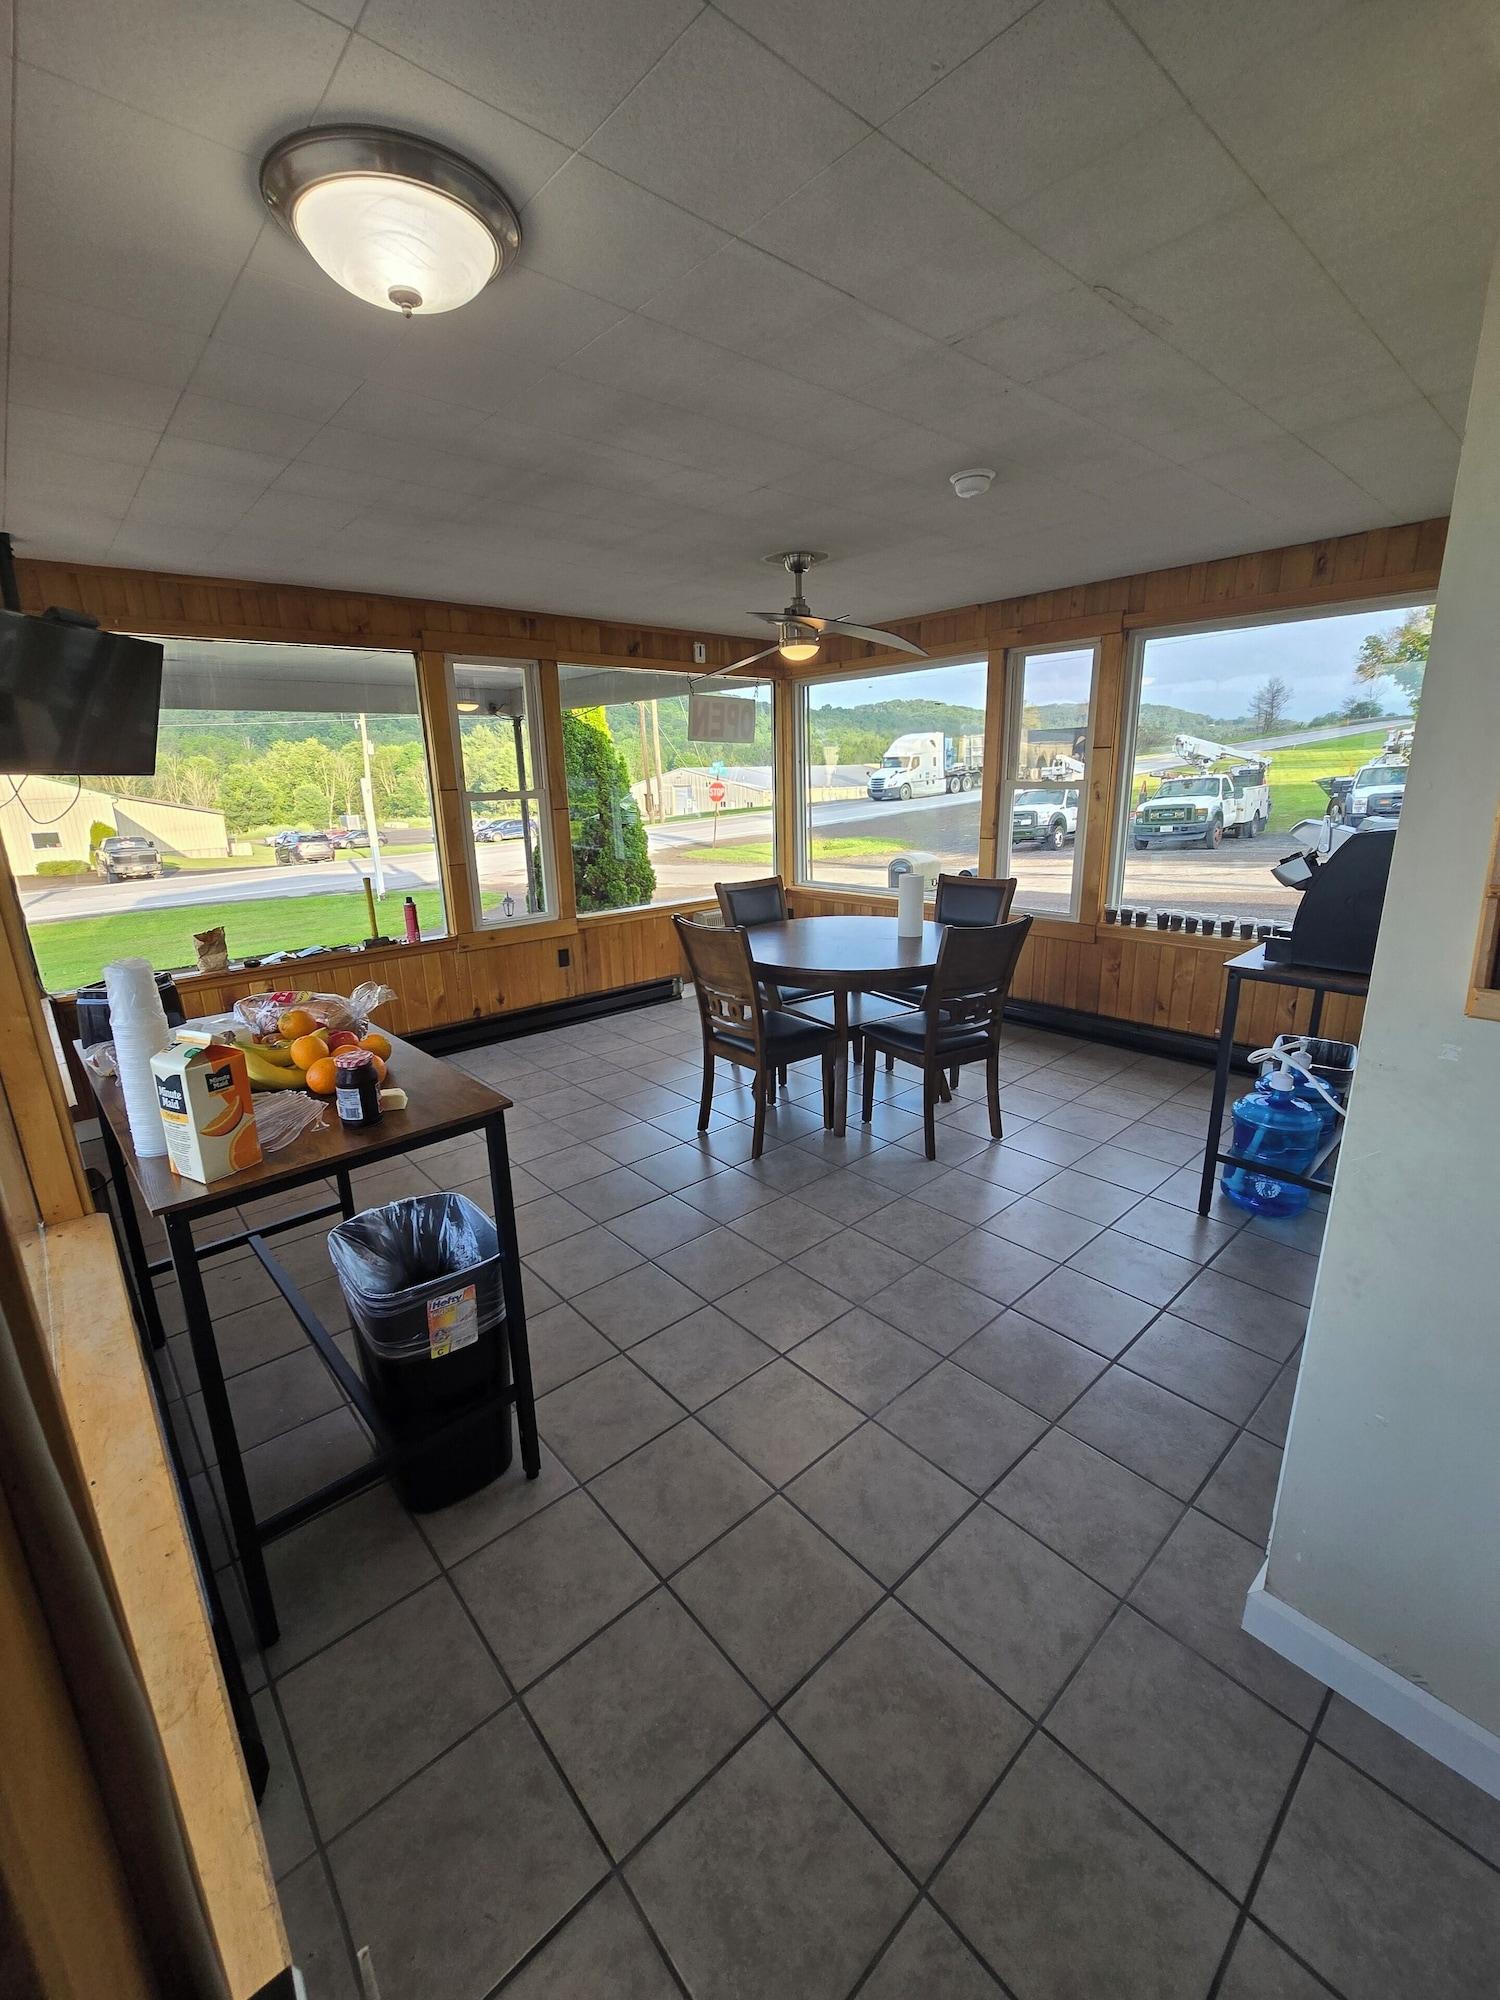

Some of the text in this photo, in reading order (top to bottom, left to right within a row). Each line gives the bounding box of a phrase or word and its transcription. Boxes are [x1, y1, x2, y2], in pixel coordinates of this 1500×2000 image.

[709, 787, 725, 797] STOP
[158, 1085, 182, 1100] Minute
[162, 1096, 180, 1110] Maid
[432, 1294, 463, 1311] Hefty
